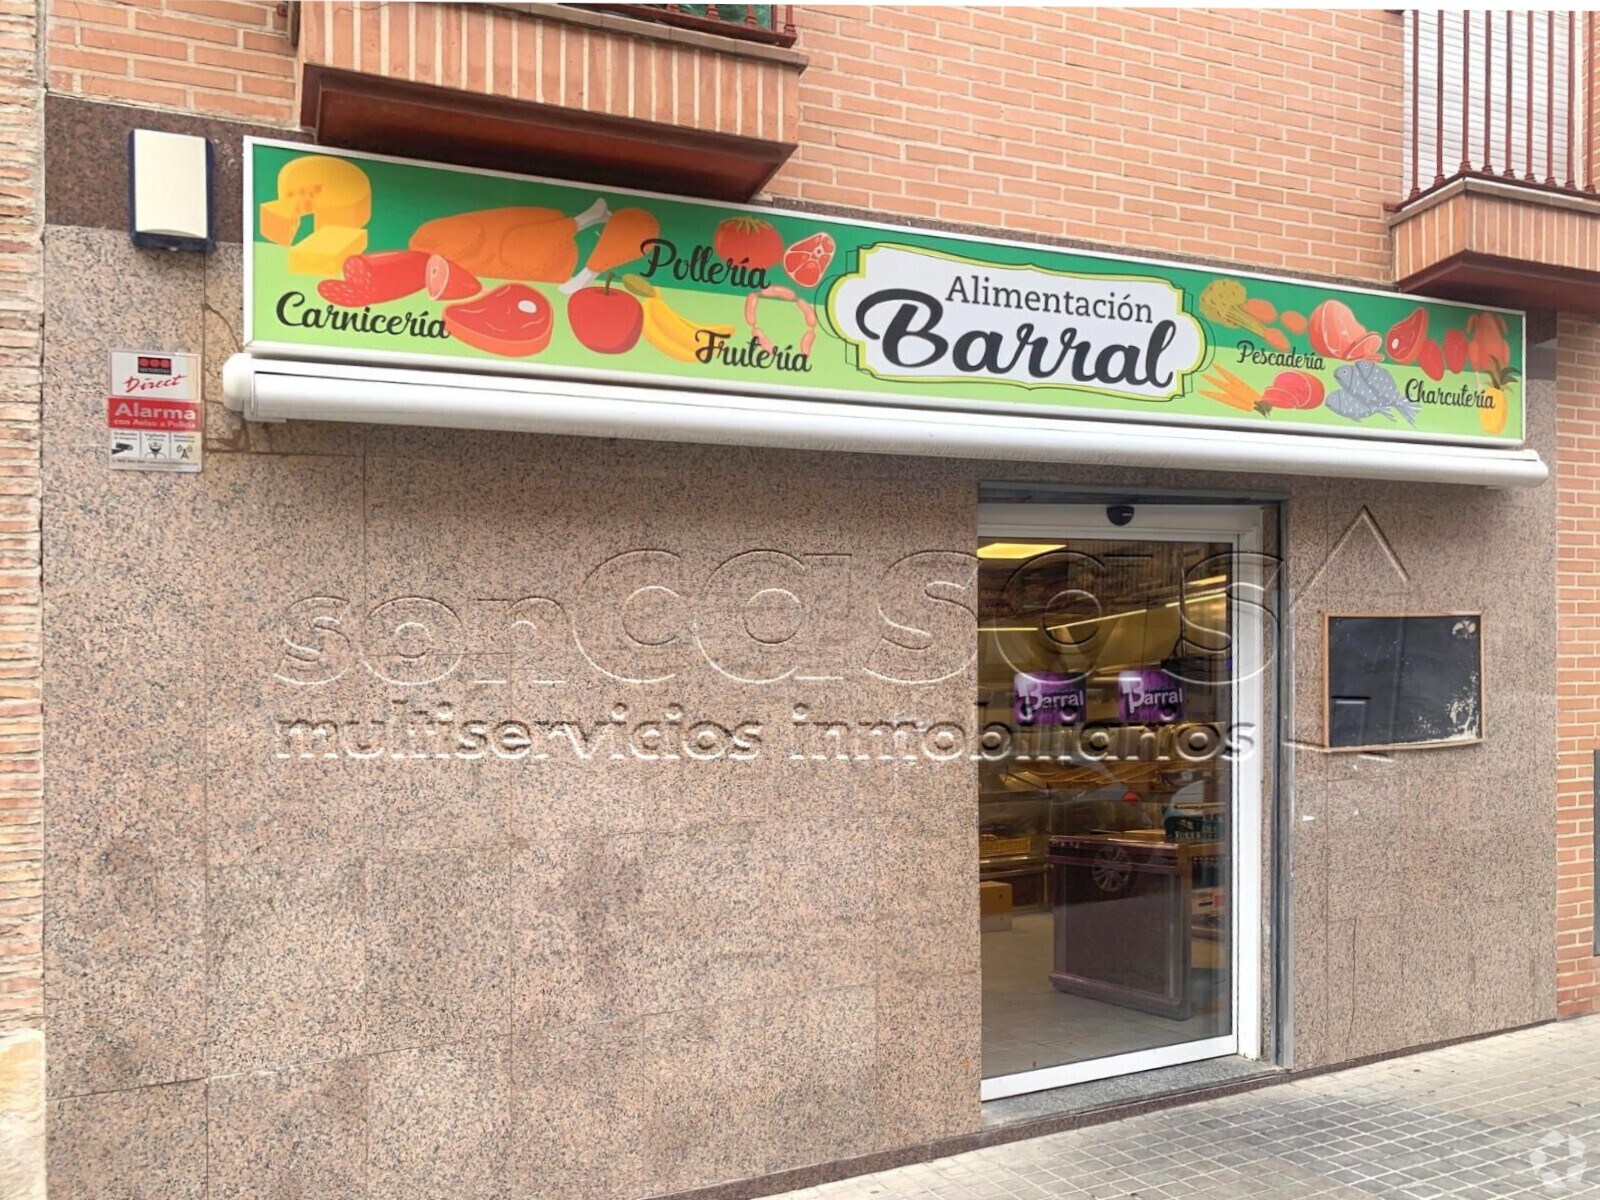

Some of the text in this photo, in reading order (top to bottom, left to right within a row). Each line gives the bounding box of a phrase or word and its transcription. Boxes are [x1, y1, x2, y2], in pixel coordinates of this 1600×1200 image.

[640, 238, 771, 290] Pollería
[275, 291, 451, 340] Carnicería
[945, 275, 1154, 324] Alimentación
[695, 328, 813, 373] Frutería
[855, 288, 1177, 388] Barral
[1236, 340, 1326, 371] Pescadería
[123, 374, 187, 393] Direct
[1405, 378, 1496, 410] Charcutería
[114, 402, 197, 420] Alarma
[1017, 678, 1084, 718] Barral
[1121, 676, 1184, 715] Barral
